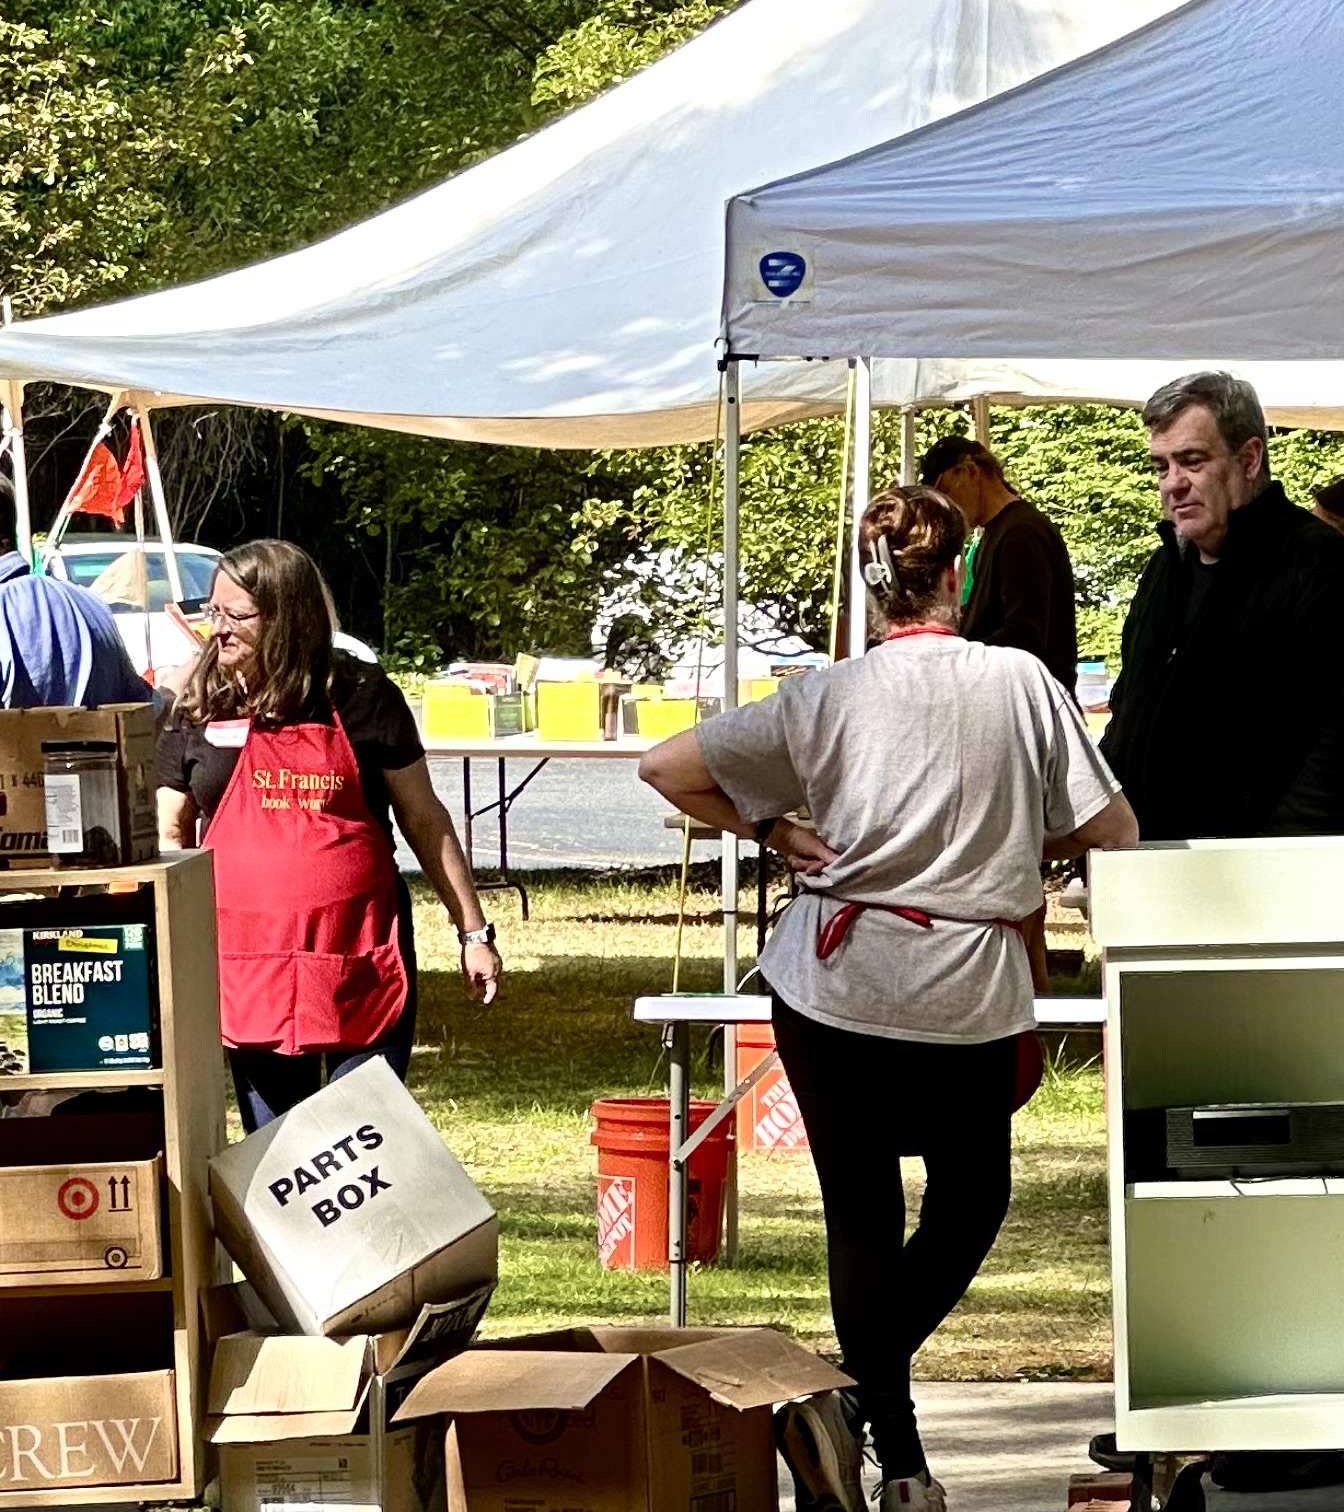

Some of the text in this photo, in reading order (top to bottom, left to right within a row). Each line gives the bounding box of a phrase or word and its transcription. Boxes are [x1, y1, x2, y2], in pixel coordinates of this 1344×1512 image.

[279, 768, 345, 791] Francis
[261, 794, 291, 810] book
[32, 929, 84, 941] KIRKLAND
[31, 960, 124, 984] BREAKFAST
[32, 983, 85, 1005] BLEND
[268, 1124, 384, 1207] PARTS
[311, 1165, 393, 1228] BOX
